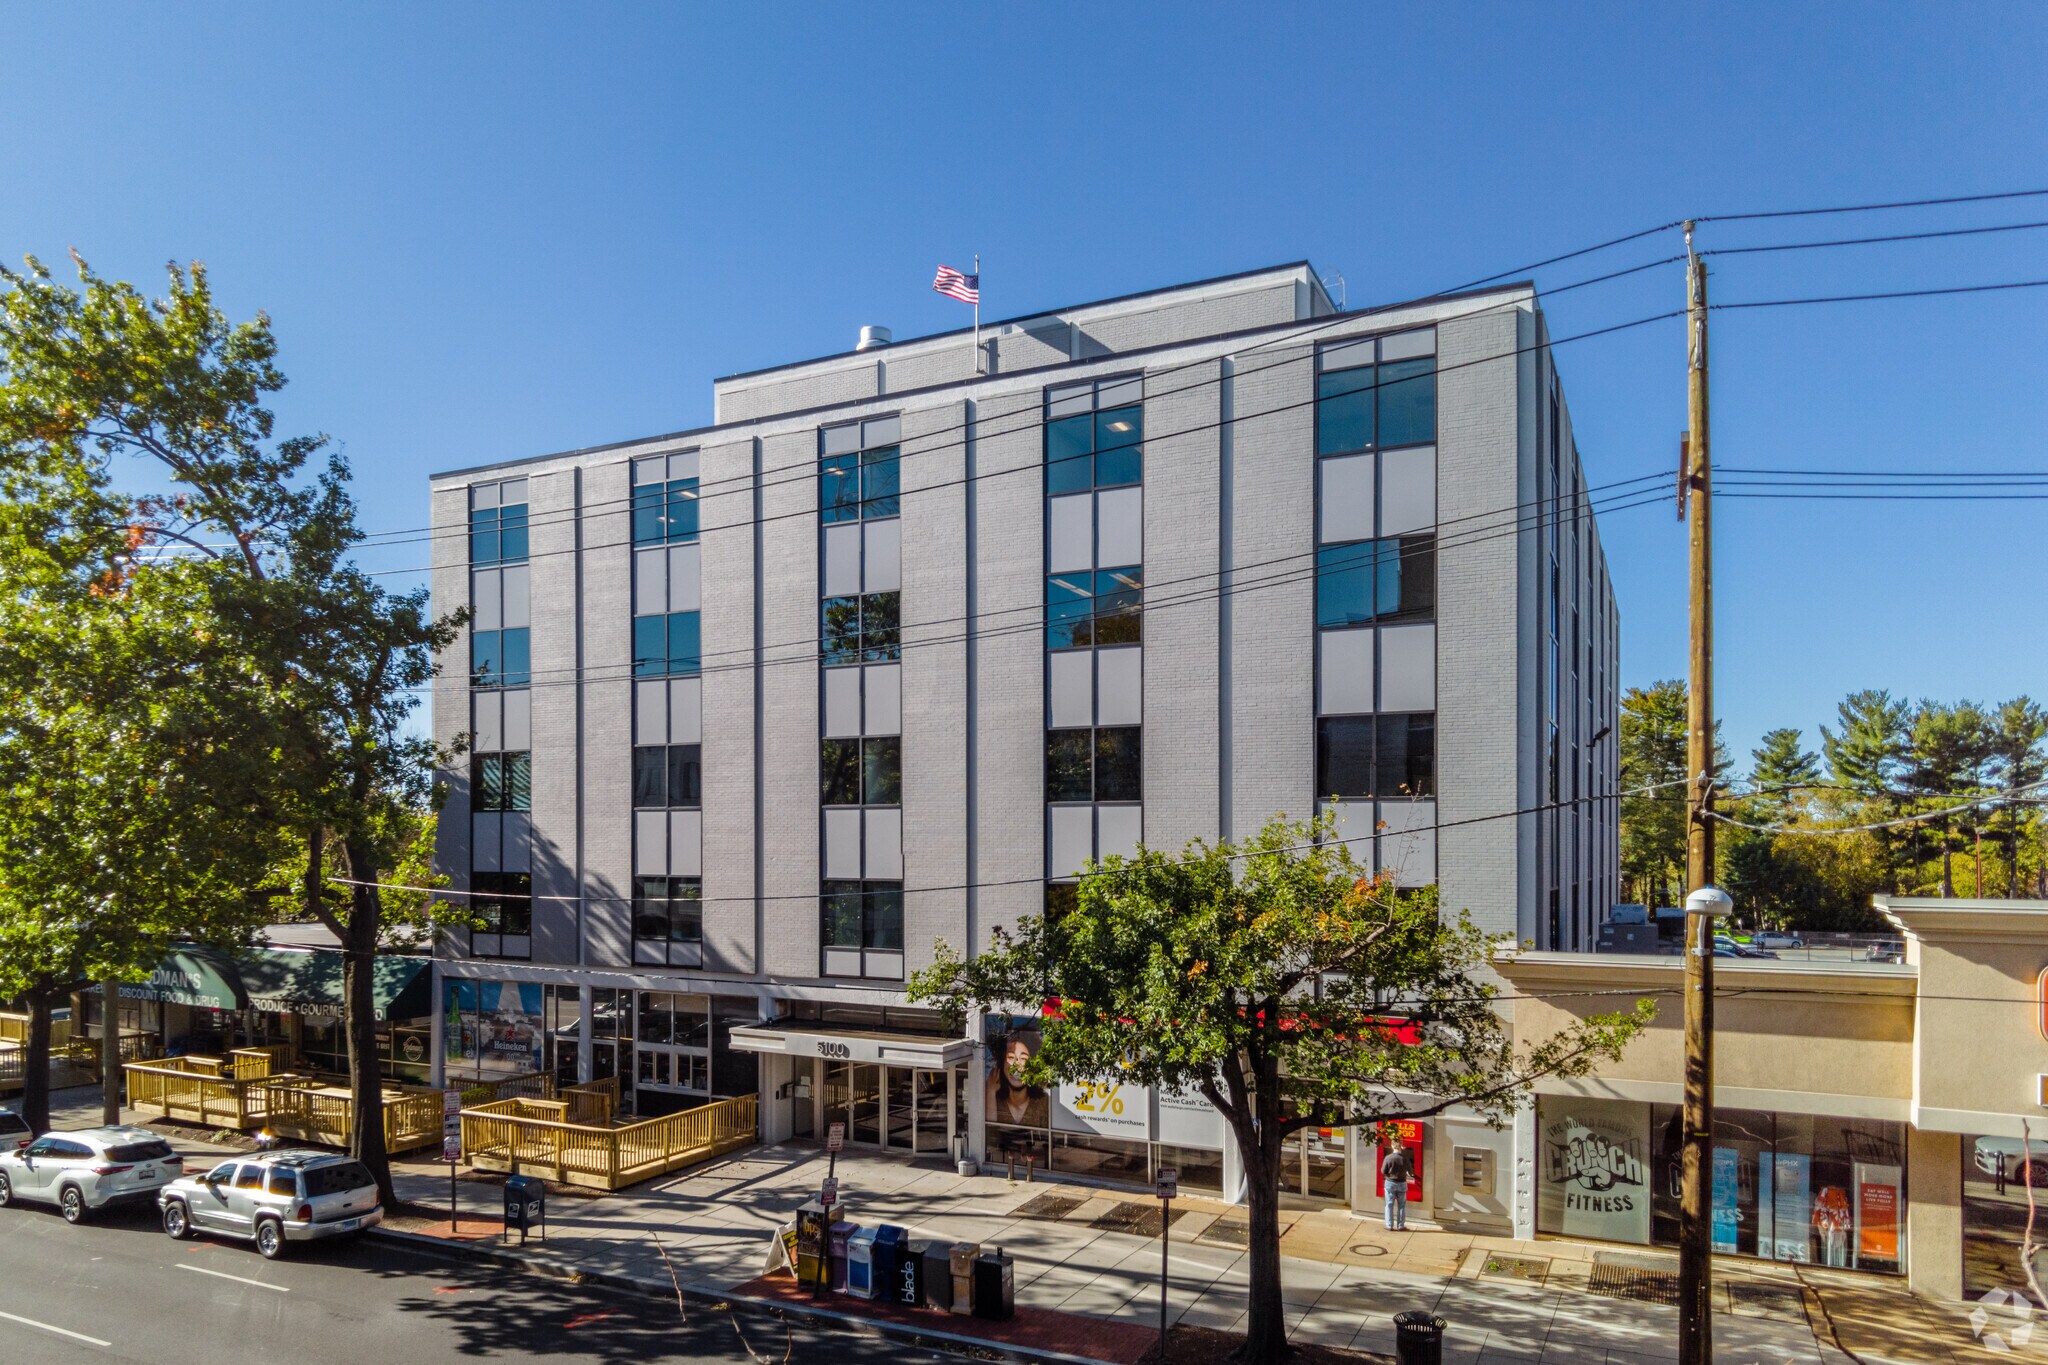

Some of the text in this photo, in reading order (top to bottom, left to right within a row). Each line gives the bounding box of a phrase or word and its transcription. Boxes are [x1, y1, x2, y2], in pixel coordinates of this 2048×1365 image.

[146, 969, 201, 989] DMAN'S
[118, 987, 220, 1007] DISCOUNT FOOD & DRUG
[248, 998, 345, 1018] PRODUCE GOURME
[494, 1040, 527, 1052] Heineken
[1076, 1080, 1124, 1115] 2%
[1160, 1097, 1180, 1105] Active
[1118, 1119, 1145, 1127] purchases
[1564, 1118, 1594, 1130] WORLD
[1544, 1137, 1642, 1185] CRUNCH
[1566, 1193, 1634, 1212] FITNESS
[1711, 1208, 1745, 1224] NESS
[901, 1260, 915, 1303] blade
